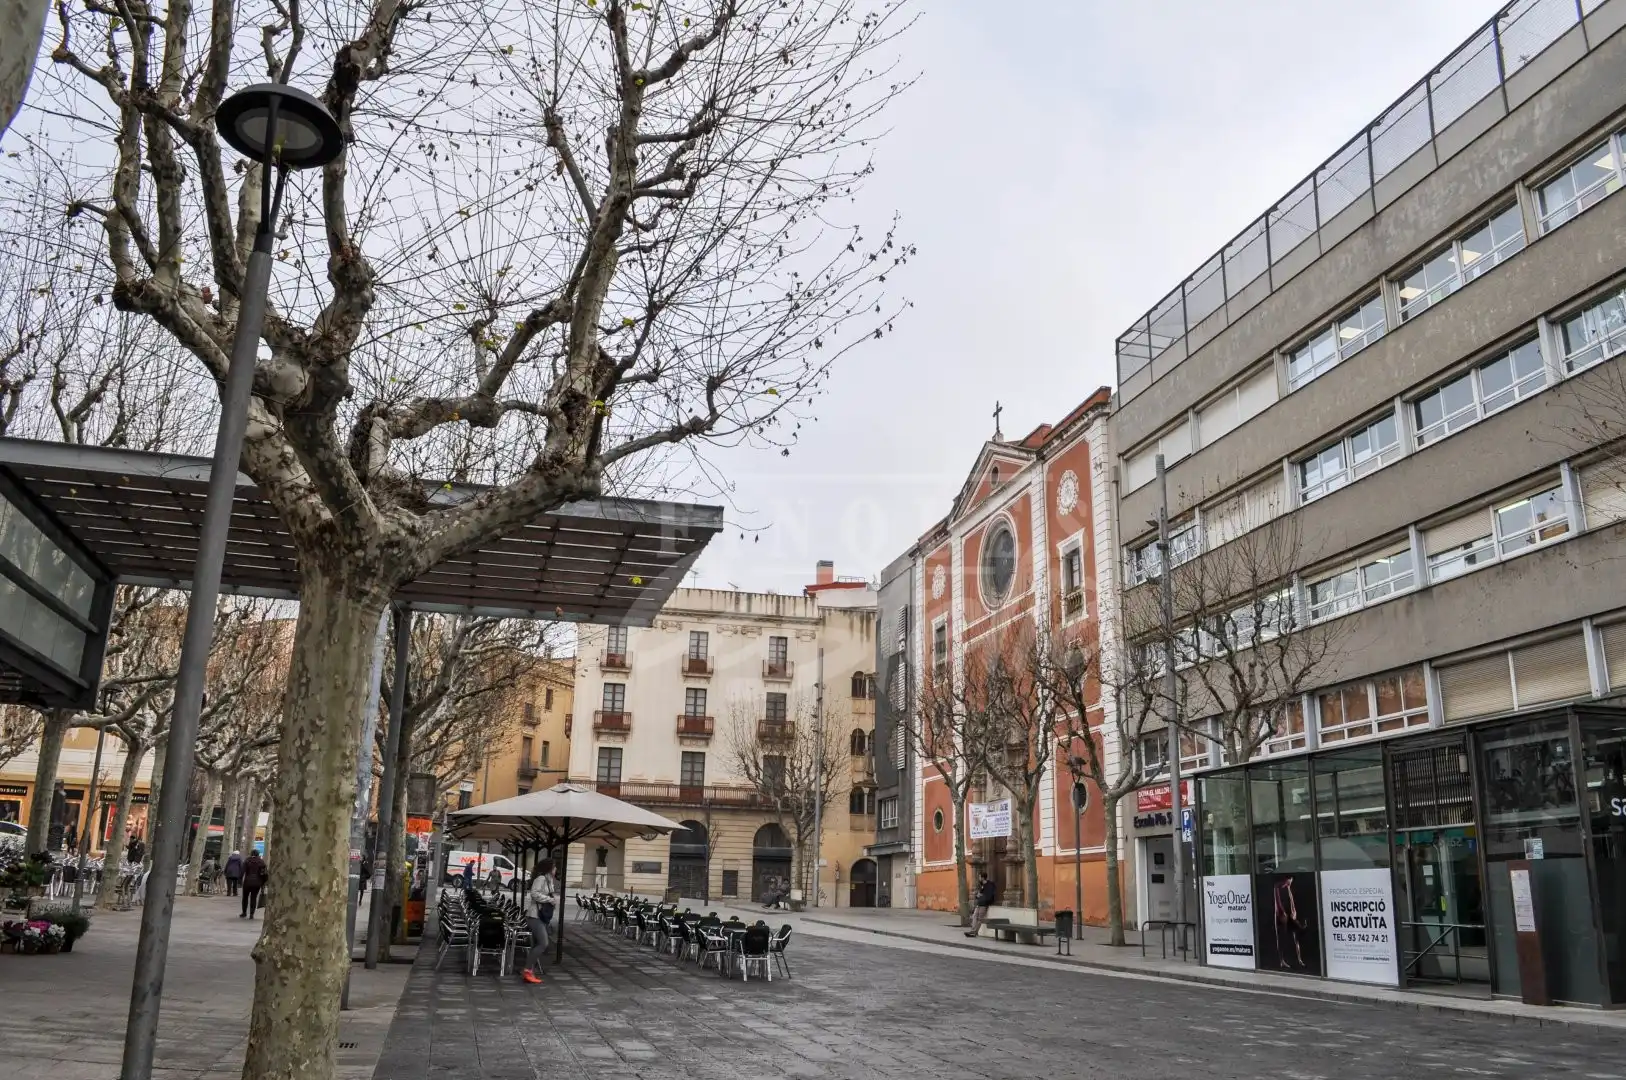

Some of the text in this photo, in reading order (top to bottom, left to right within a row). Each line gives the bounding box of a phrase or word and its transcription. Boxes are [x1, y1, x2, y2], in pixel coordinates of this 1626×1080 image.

[1183, 812, 1190, 826] P
[1359, 887, 1384, 895] ESPECIAL
[1207, 890, 1247, 908] YogaOne
[1330, 898, 1386, 912] INSCRIPCIÓ
[1332, 913, 1388, 929] GRATUÏTA
[1332, 933, 1388, 943] TEL. 93 742 74 21
